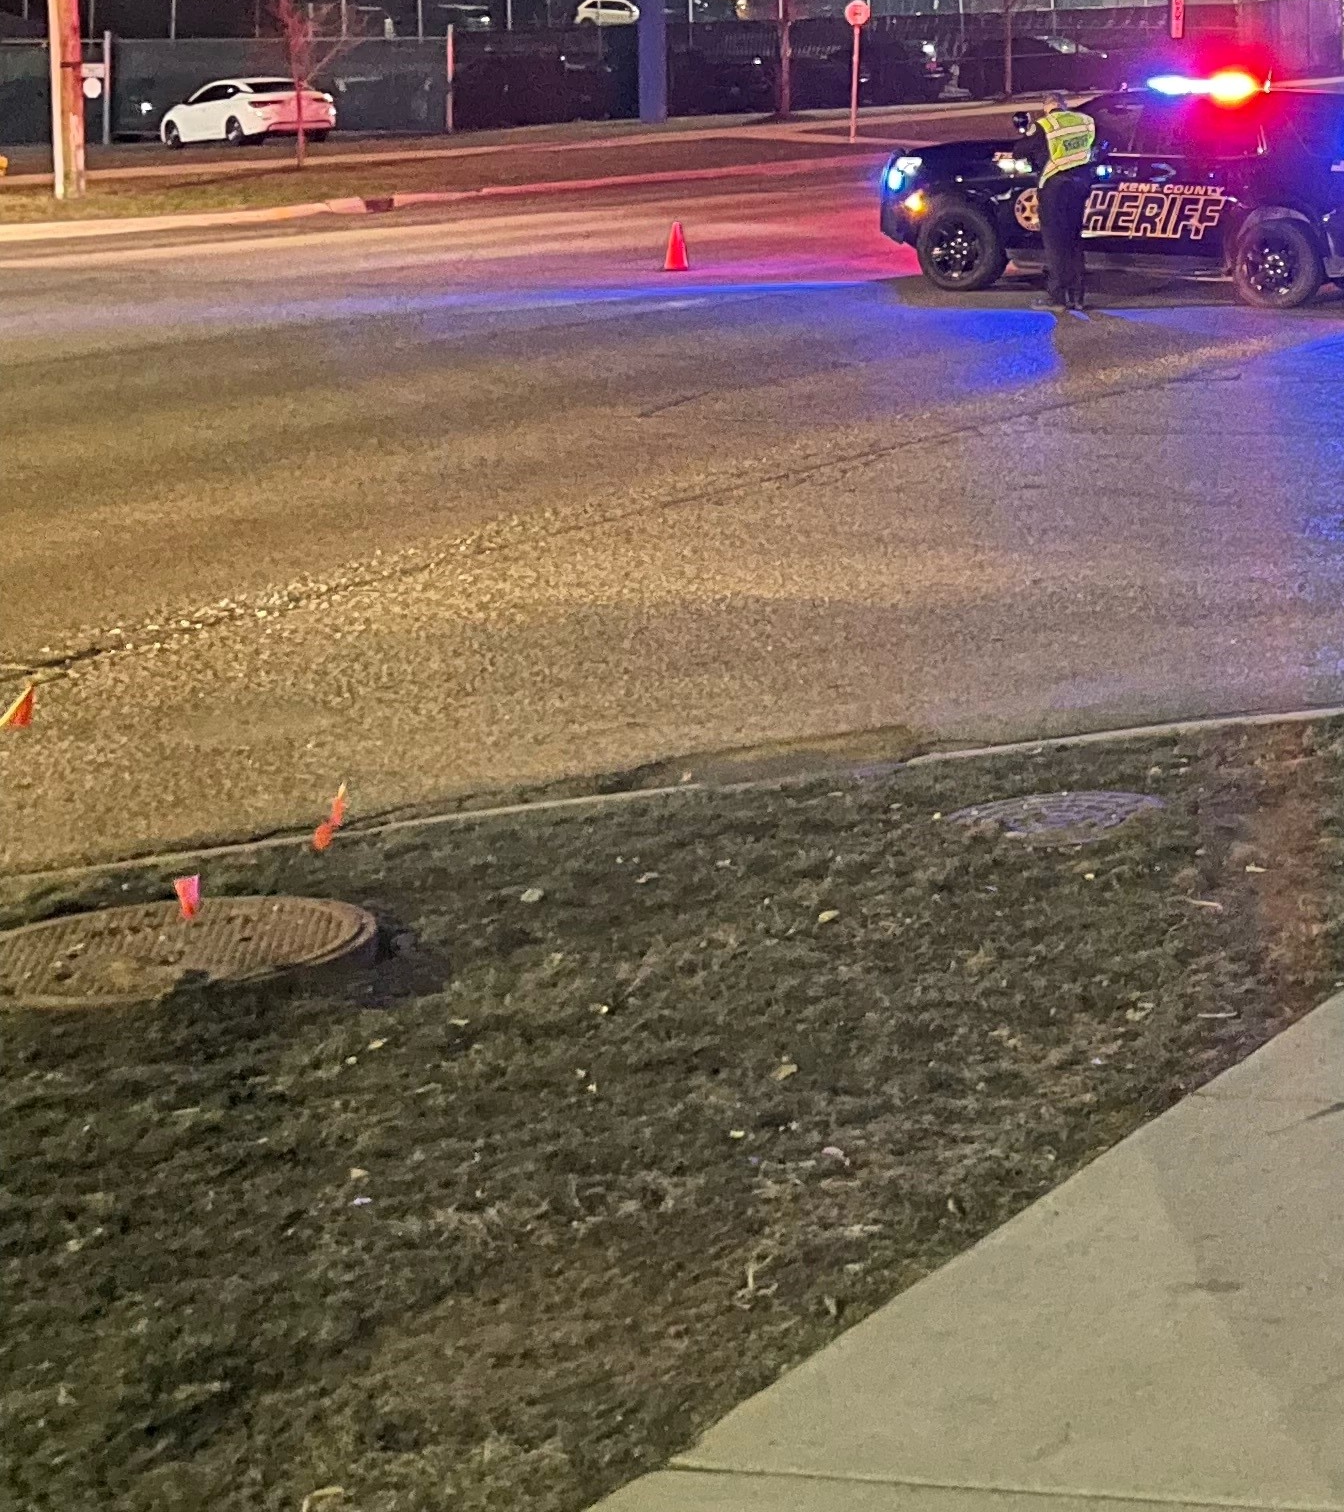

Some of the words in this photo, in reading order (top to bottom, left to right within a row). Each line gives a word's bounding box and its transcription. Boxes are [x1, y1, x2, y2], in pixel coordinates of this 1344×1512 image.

[1118, 182, 1160, 193] KENT
[1162, 184, 1225, 196] COUNTY
[1083, 190, 1226, 240] HERIFF
